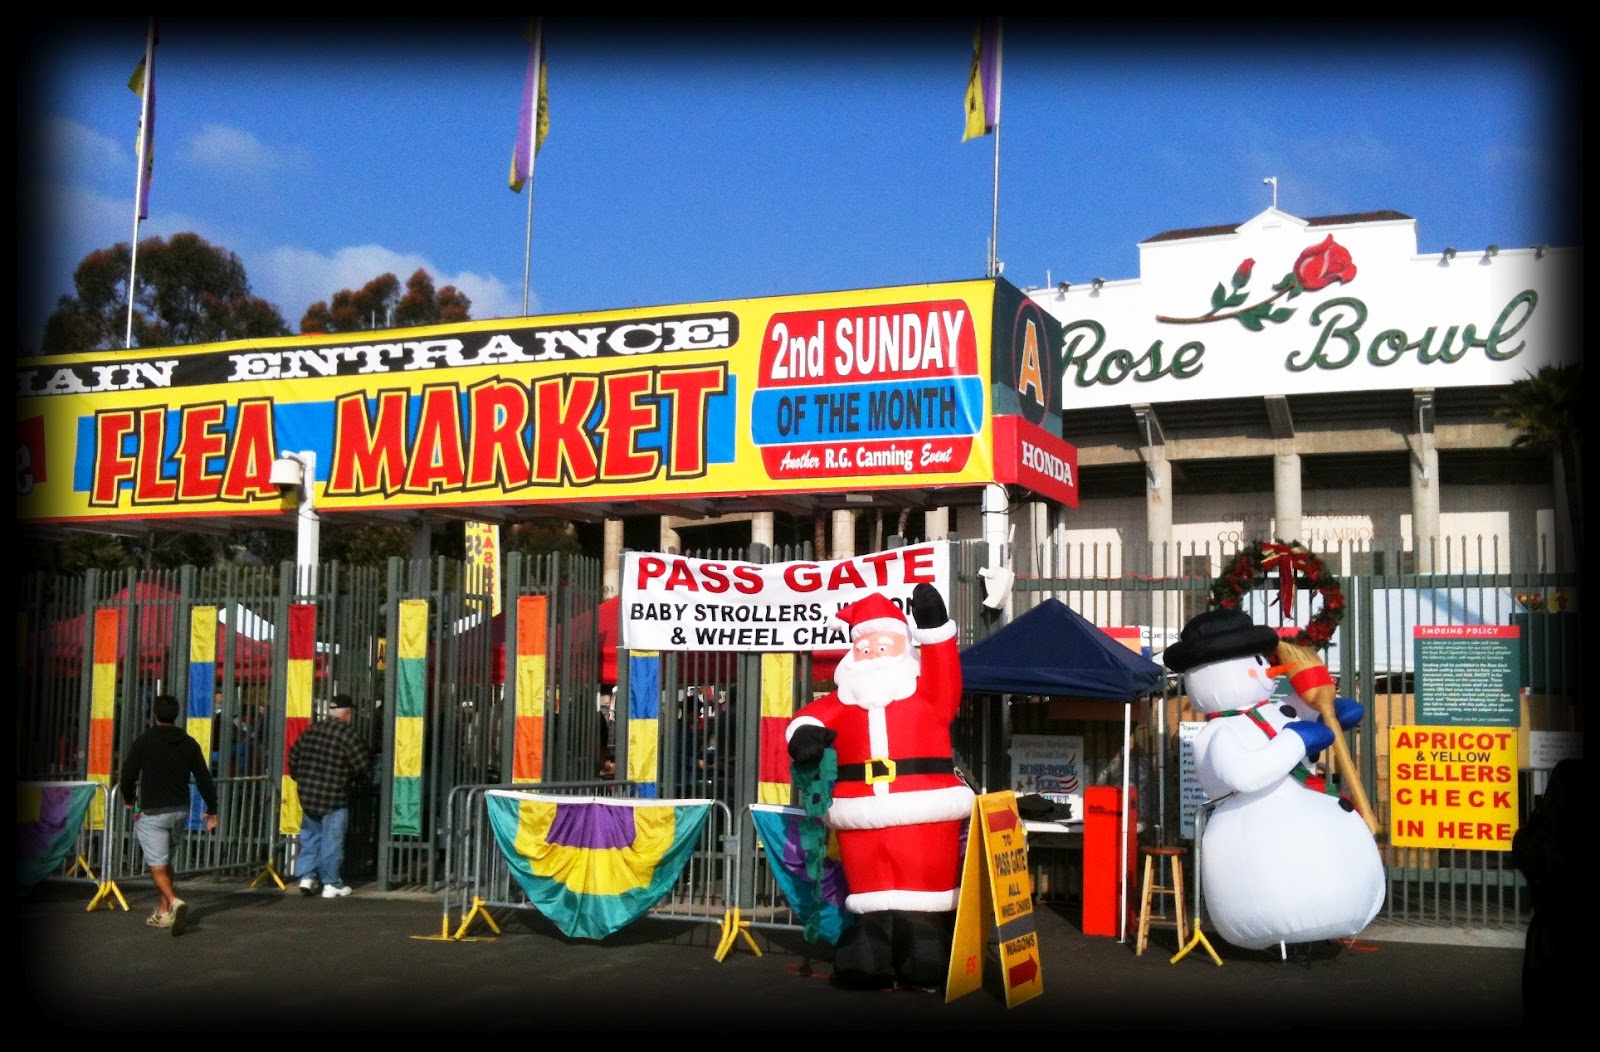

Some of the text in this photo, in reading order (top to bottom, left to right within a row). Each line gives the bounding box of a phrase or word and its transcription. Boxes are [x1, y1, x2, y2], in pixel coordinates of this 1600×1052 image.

[227, 317, 730, 382] ENTRANCE
[770, 309, 965, 380] 2nd SUNDAY
[1061, 289, 1539, 388] Rose Bowl
[1018, 318, 1045, 407] A
[776, 386, 956, 437] OF THE MONTH
[87, 361, 729, 508] FLEA MARKET
[779, 443, 953, 472] Another R.G. Canning Event
[1021, 440, 1074, 488] HONDA
[636, 547, 936, 594] PASS GATE
[630, 603, 688, 621] BABY
[693, 602, 829, 625] STROLLERS,
[670, 626, 687, 645] &
[695, 627, 784, 646] WHEEL
[1421, 627, 1499, 635] SMOKING POLICY
[1395, 732, 1512, 751] APRICOT
[1416, 751, 1491, 763] & YELLOW
[1396, 763, 1512, 783] SELLERS
[1396, 788, 1512, 809] CHECK
[1002, 834, 1013, 847] TO
[1397, 820, 1512, 841] IN HERE
[1008, 882, 1021, 897] ALL
[1005, 933, 1036, 957] WAGONS
